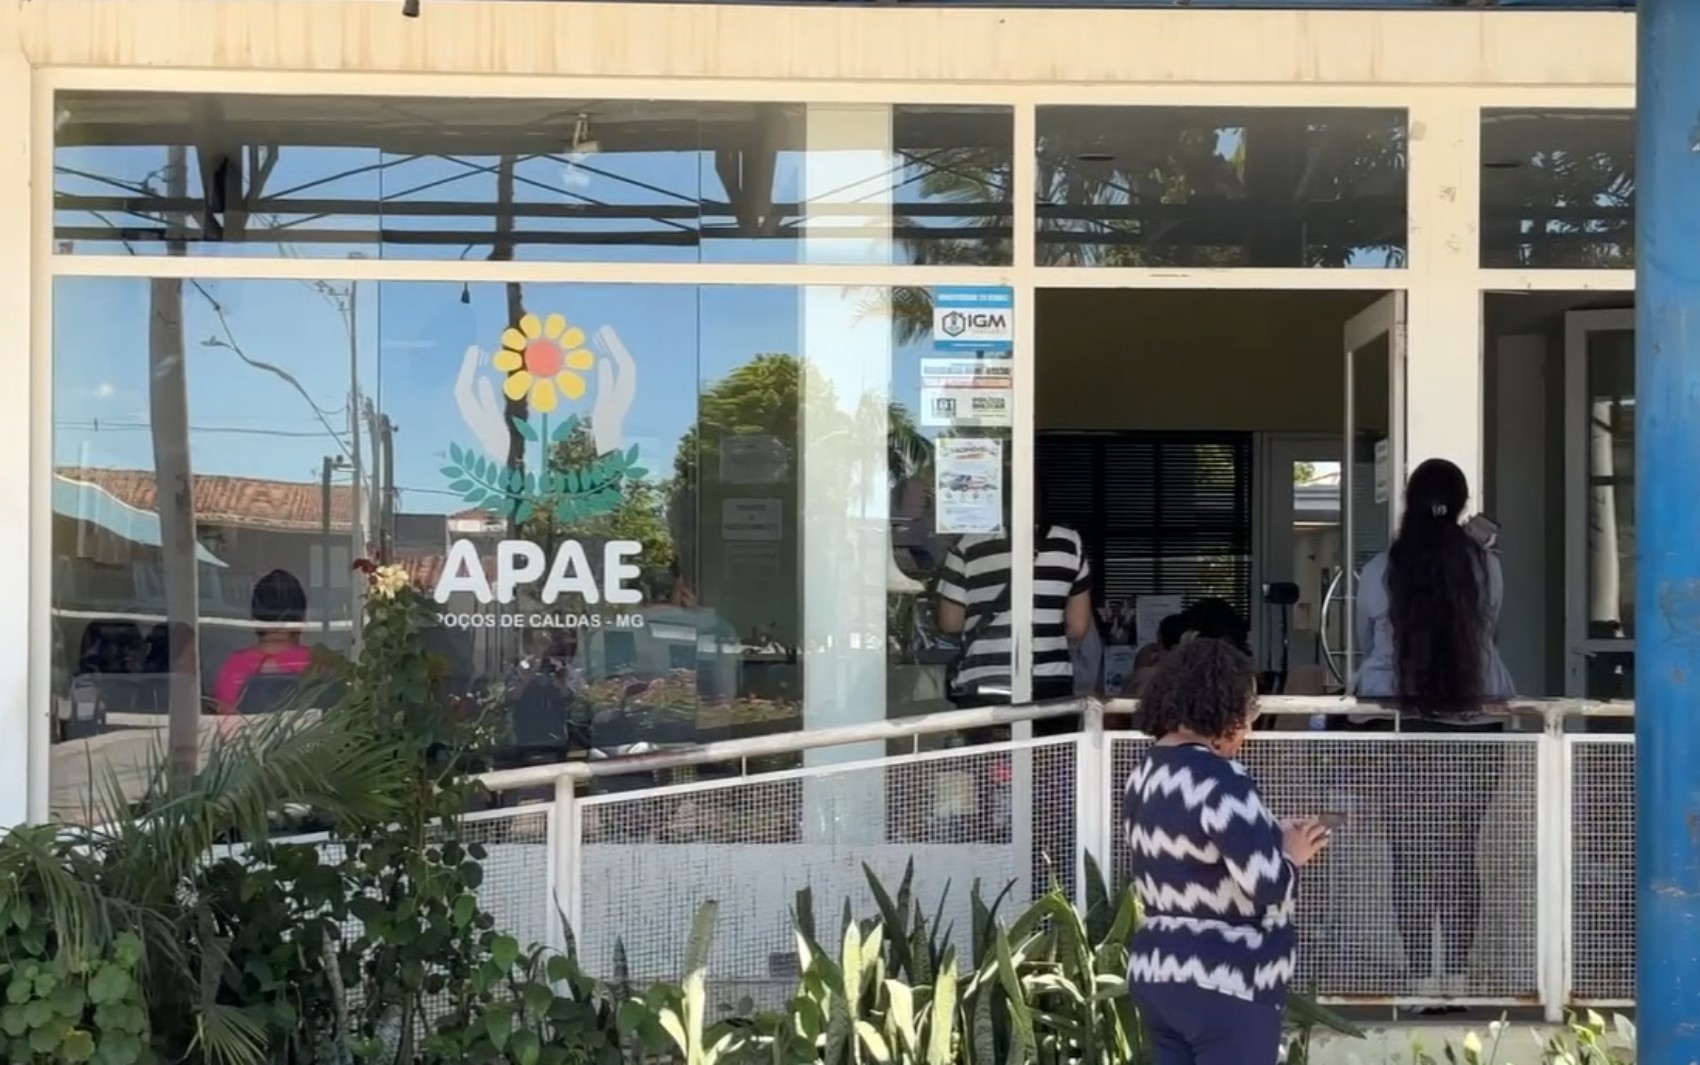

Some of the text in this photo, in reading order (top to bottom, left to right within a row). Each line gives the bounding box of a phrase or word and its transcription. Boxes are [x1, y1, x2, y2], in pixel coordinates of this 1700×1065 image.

[968, 314, 1006, 328] IGM
[434, 539, 643, 604] APAE
[500, 613, 524, 627] DE
[529, 613, 601, 627] CALDAS
[615, 613, 644, 628] MG
